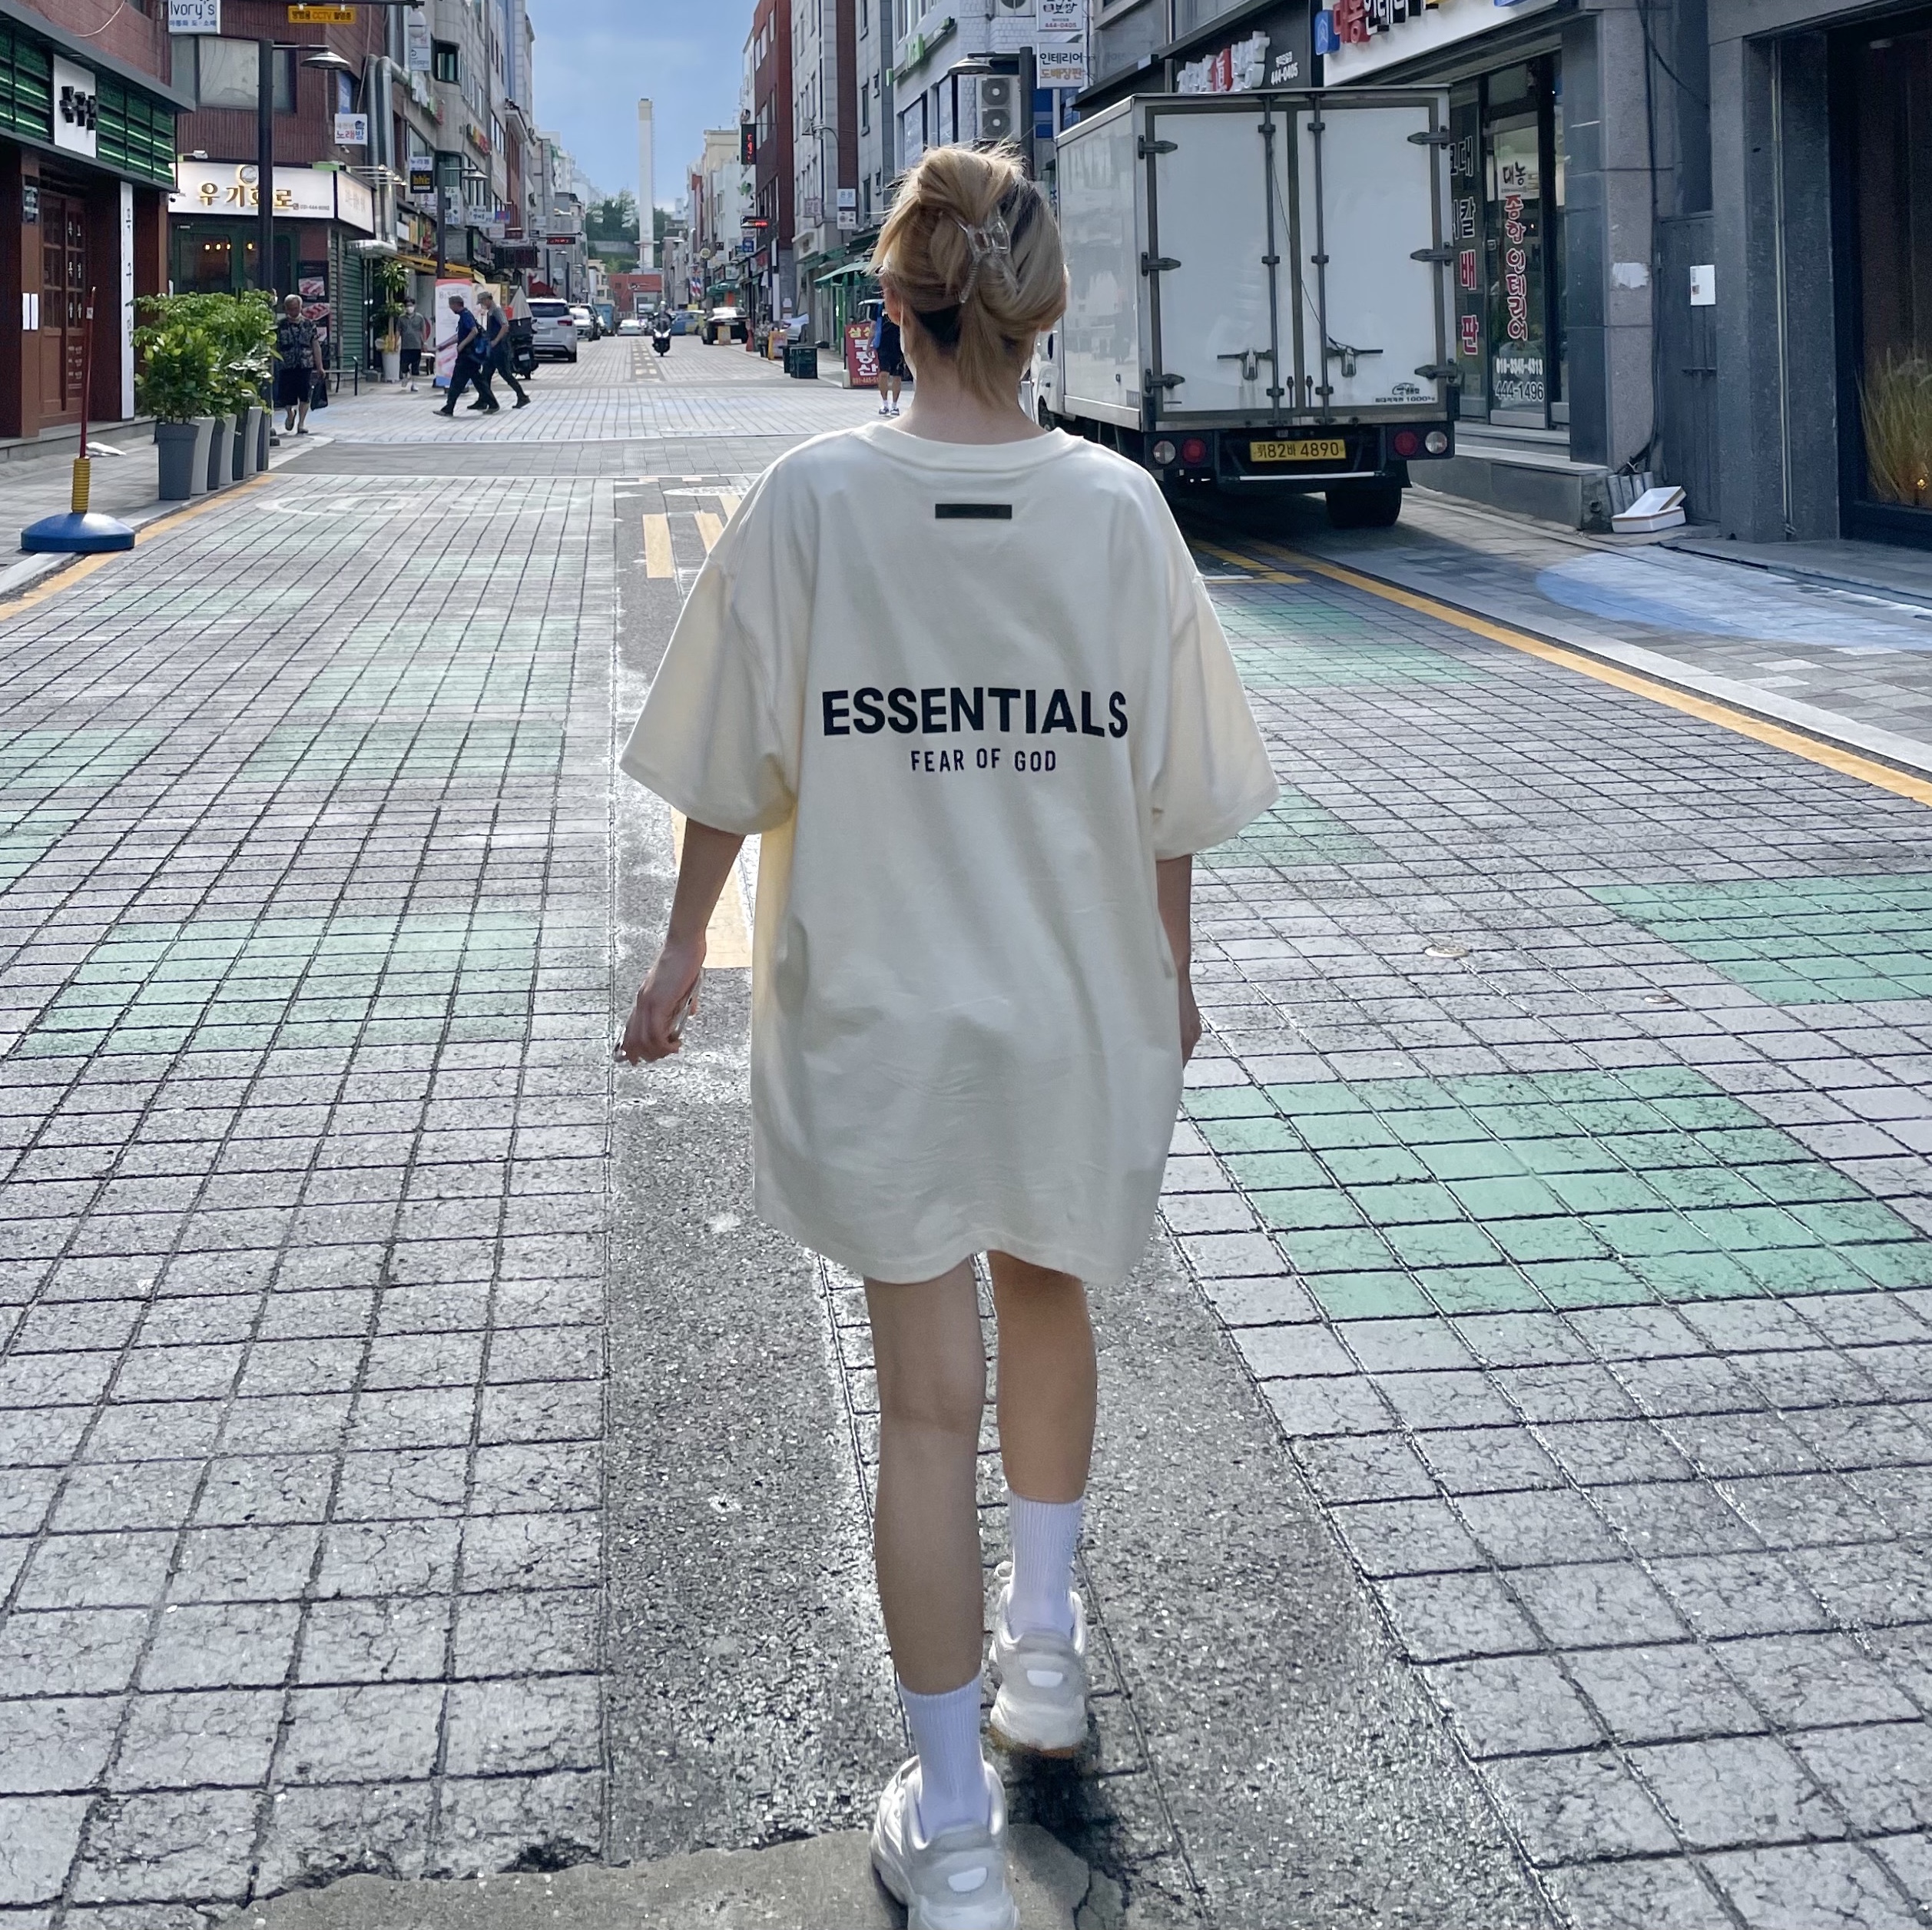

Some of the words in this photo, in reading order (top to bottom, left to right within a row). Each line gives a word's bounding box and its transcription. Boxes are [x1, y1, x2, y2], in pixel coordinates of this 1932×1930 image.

[171, 1, 215, 19] Ivory's
[312, 12, 332, 20] CCTV
[1040, 52, 1082, 65] 인테리어
[1040, 68, 1082, 80] 도배장판
[1271, 62, 1298, 85] 444-0405
[336, 130, 364, 140] 노래방
[1503, 161, 1526, 185] 대농
[1495, 380, 1545, 401] 444-1496
[1301, 442, 1339, 457] 4890
[822, 687, 1128, 738] ESSENTIALS
[911, 749, 964, 771] FEAR
[976, 748, 1001, 768] OF
[1014, 750, 1056, 771] GOD
